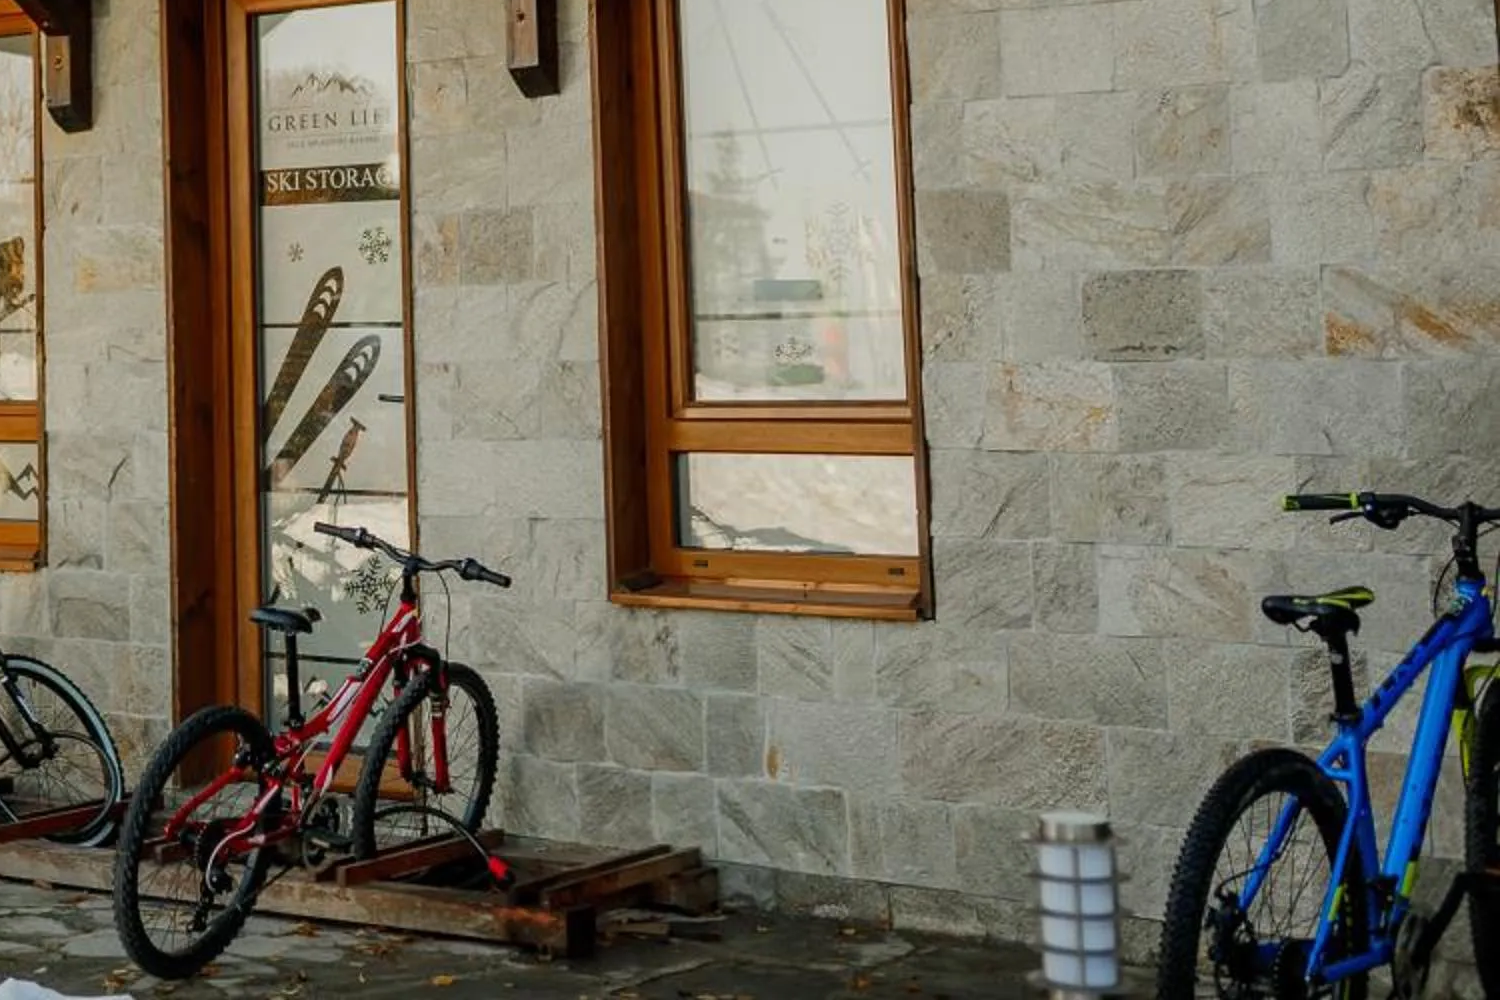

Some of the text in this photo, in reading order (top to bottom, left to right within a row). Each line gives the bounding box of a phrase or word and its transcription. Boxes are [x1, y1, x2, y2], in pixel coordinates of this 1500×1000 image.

[268, 112, 339, 132] GREEN
[267, 166, 391, 193] SKI STORAG
